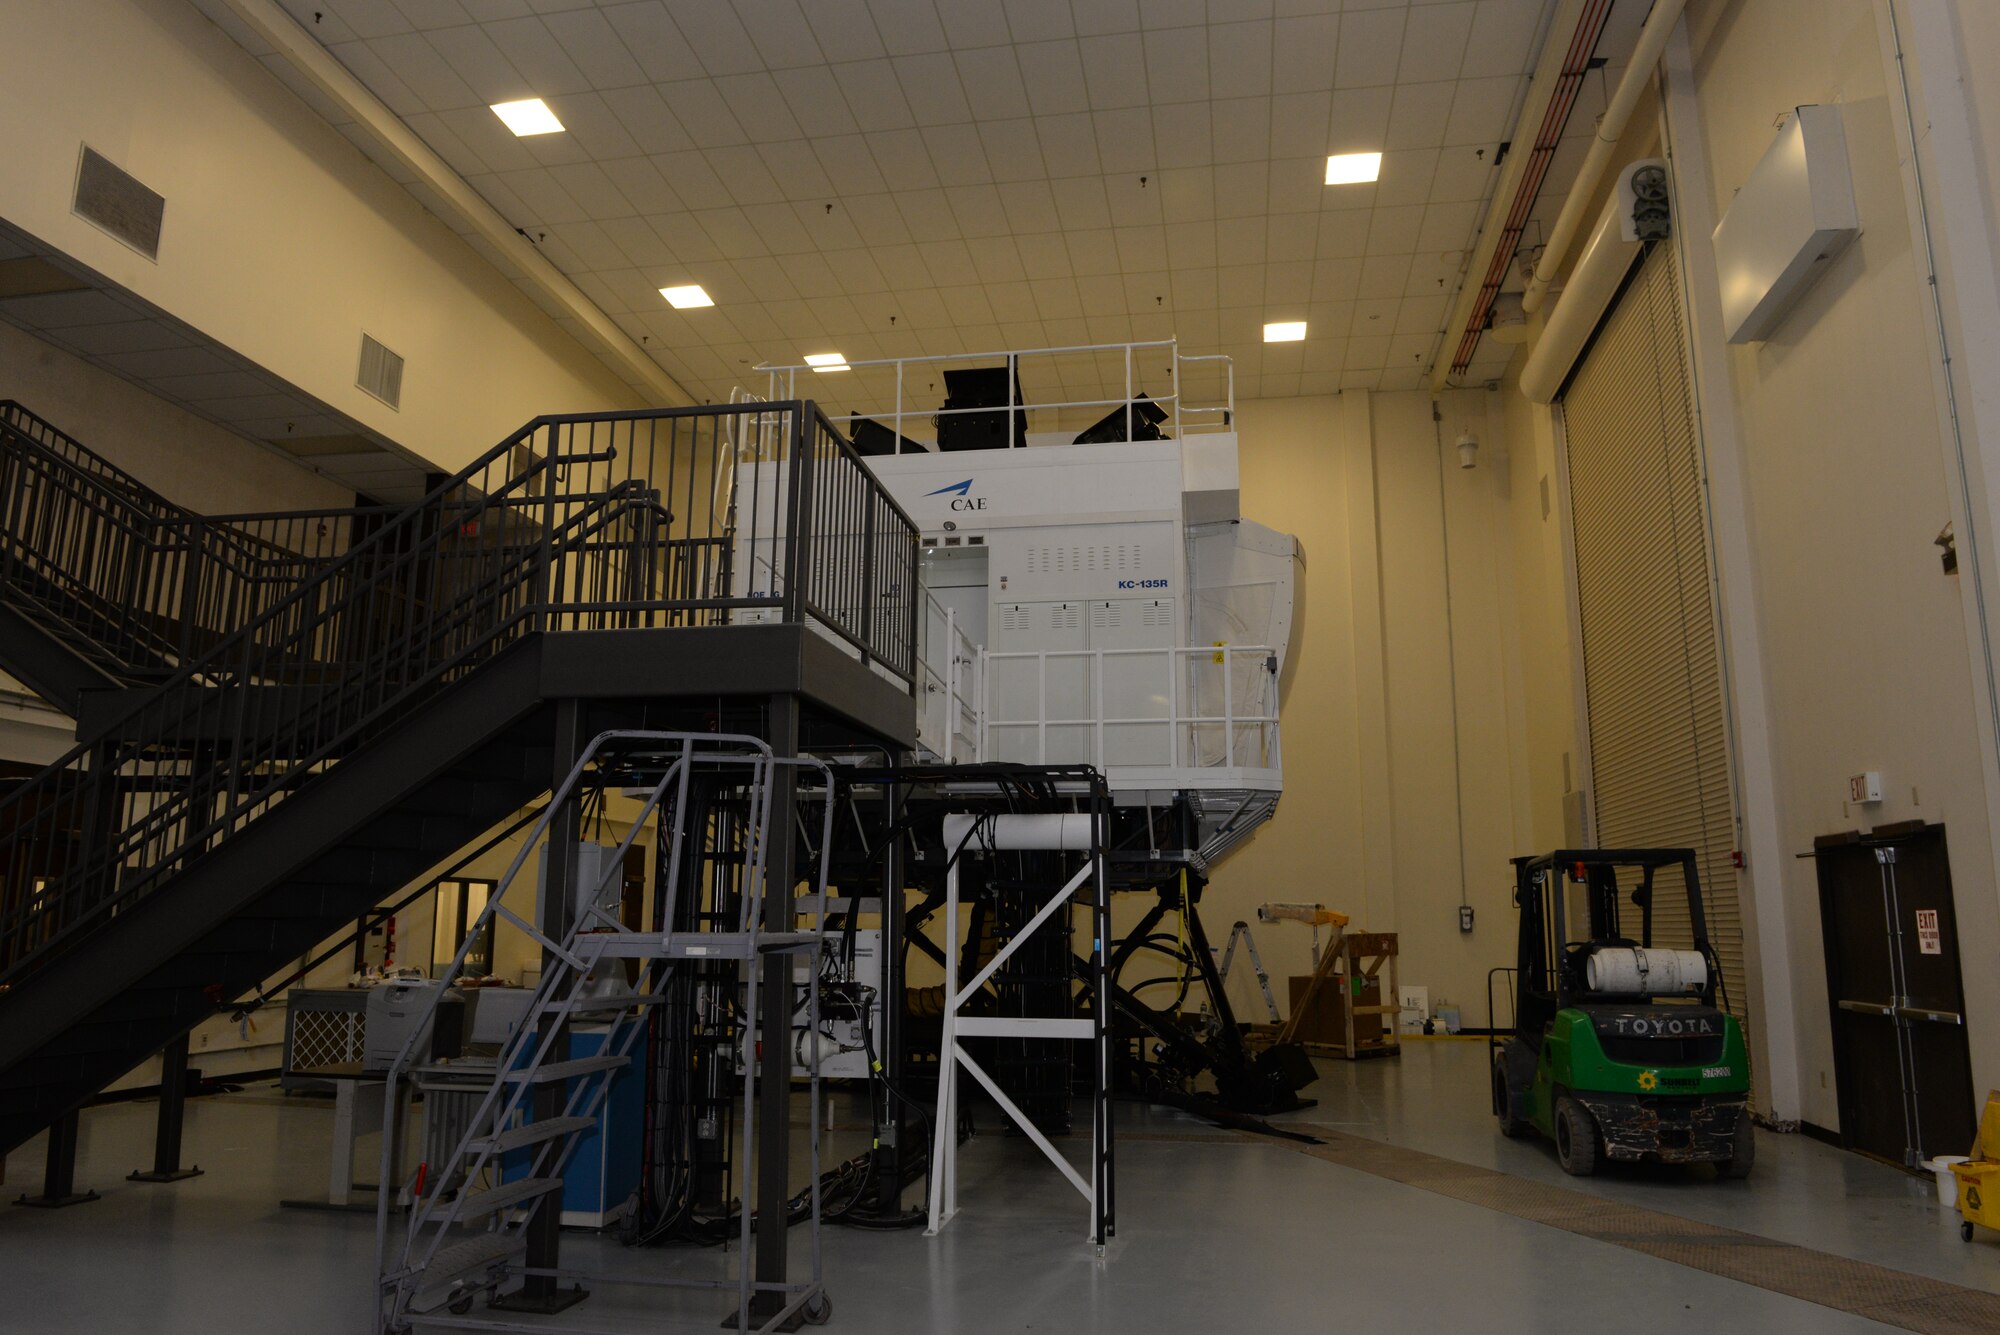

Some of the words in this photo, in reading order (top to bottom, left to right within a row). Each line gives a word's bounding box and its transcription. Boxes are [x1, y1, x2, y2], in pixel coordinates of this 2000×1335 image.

[950, 497, 987, 512] CAE
[1118, 579, 1168, 589] KC-135R
[1850, 775, 1866, 801] EXIT
[1919, 913, 1935, 929] EXIT
[1615, 1018, 1713, 1035] TOYOTA
